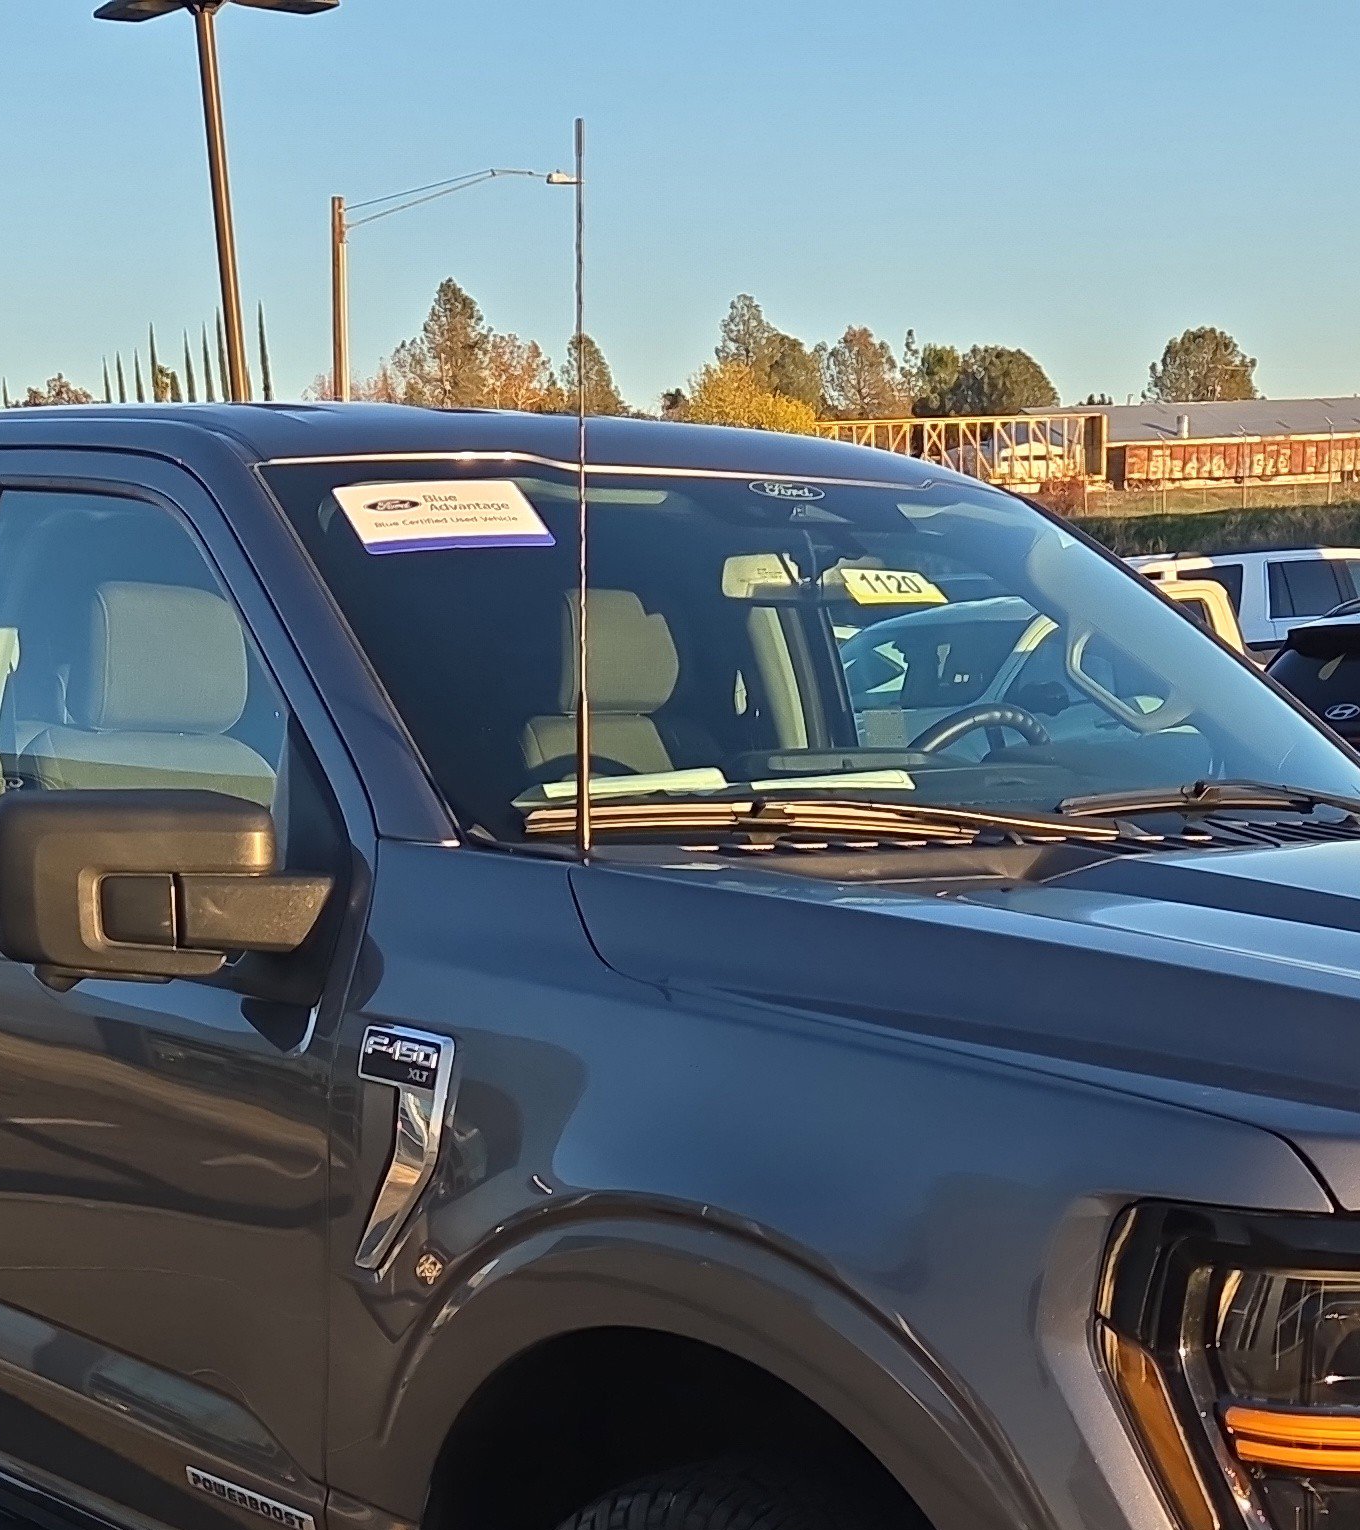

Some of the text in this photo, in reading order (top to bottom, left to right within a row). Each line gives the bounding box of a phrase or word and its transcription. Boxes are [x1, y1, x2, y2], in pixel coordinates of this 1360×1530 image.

[762, 481, 814, 498] Ford
[422, 494, 458, 503] Blue
[429, 501, 511, 512] Advantage
[374, 515, 518, 528] Blue Certified Used Vehicle
[859, 572, 922, 594] 1120
[407, 1067, 429, 1083] XLT
[191, 1472, 307, 1530] POWERBOOST
